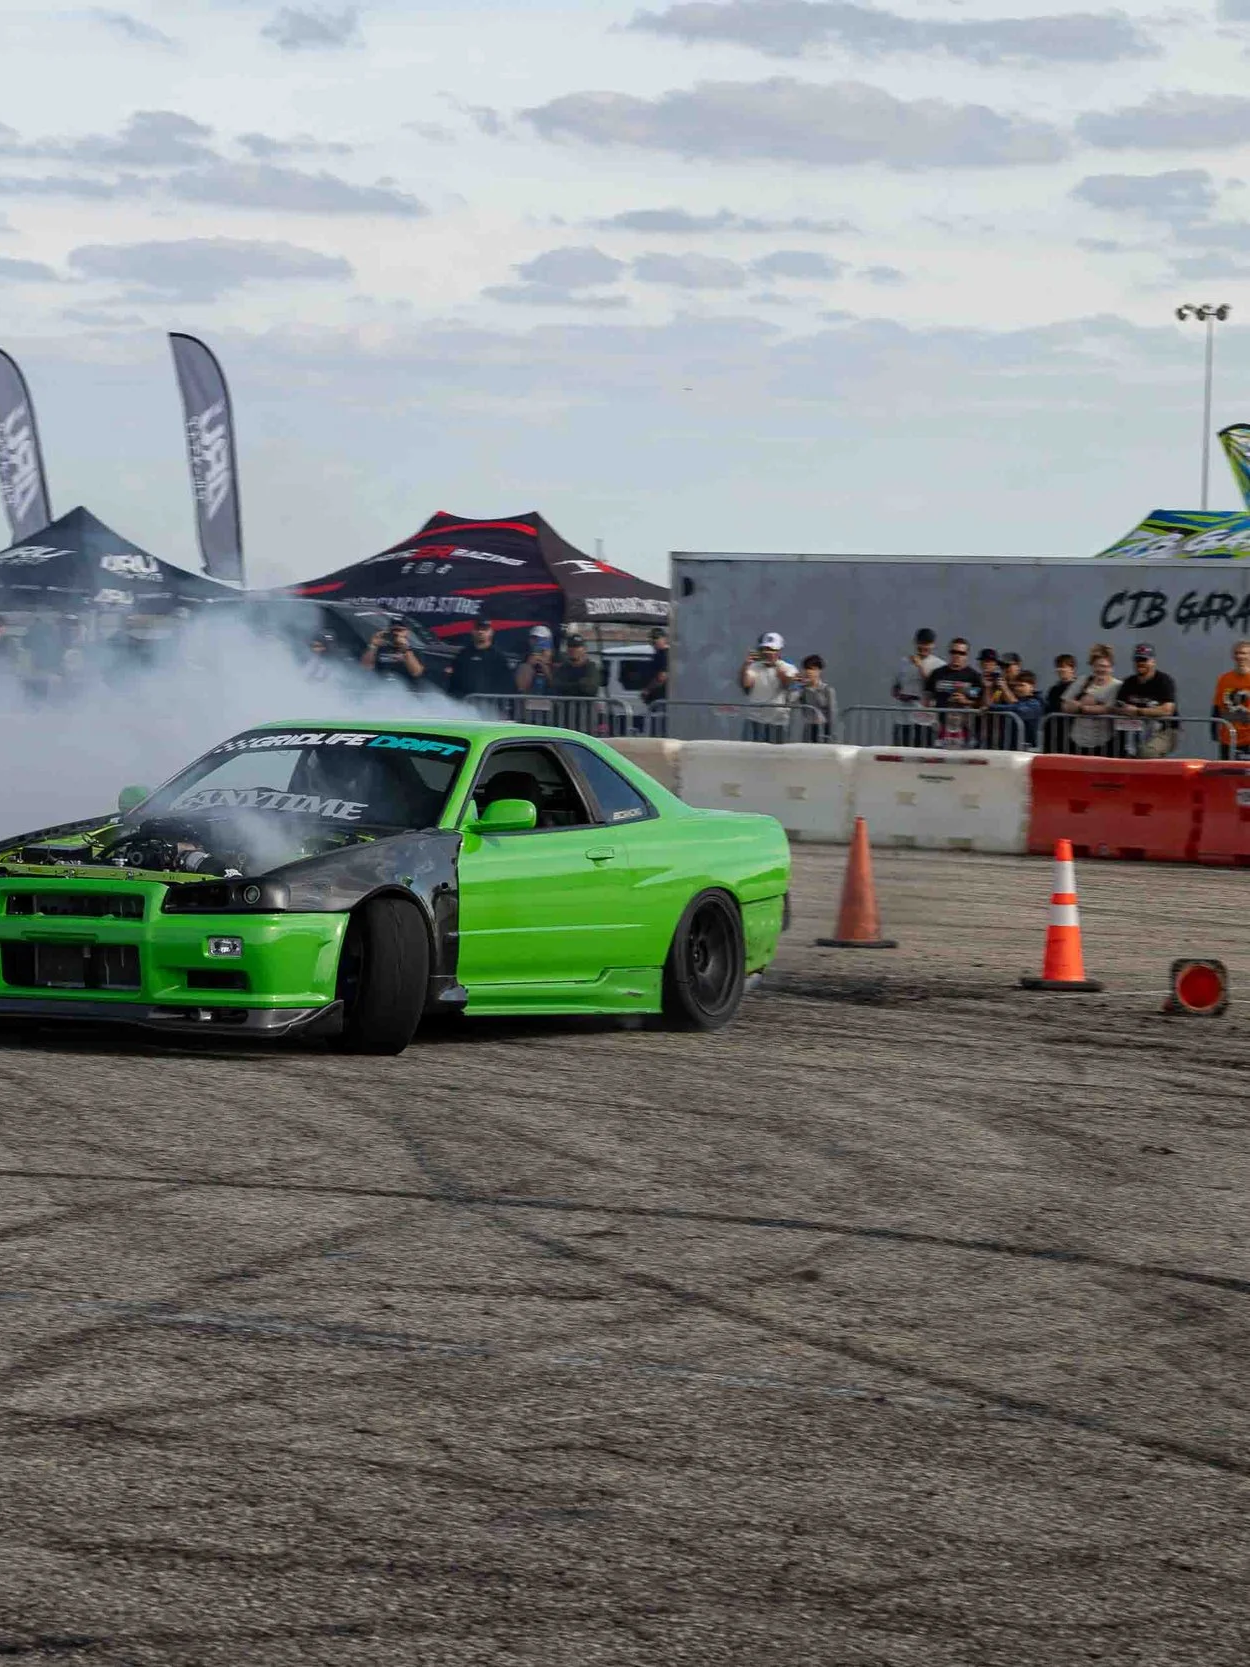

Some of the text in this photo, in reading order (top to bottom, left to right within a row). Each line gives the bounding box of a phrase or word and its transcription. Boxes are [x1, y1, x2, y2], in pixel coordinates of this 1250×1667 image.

[450, 548, 528, 567] RACING
[1101, 588, 1167, 630] CTB
[250, 733, 466, 755] GRIDLIFE DRIFT
